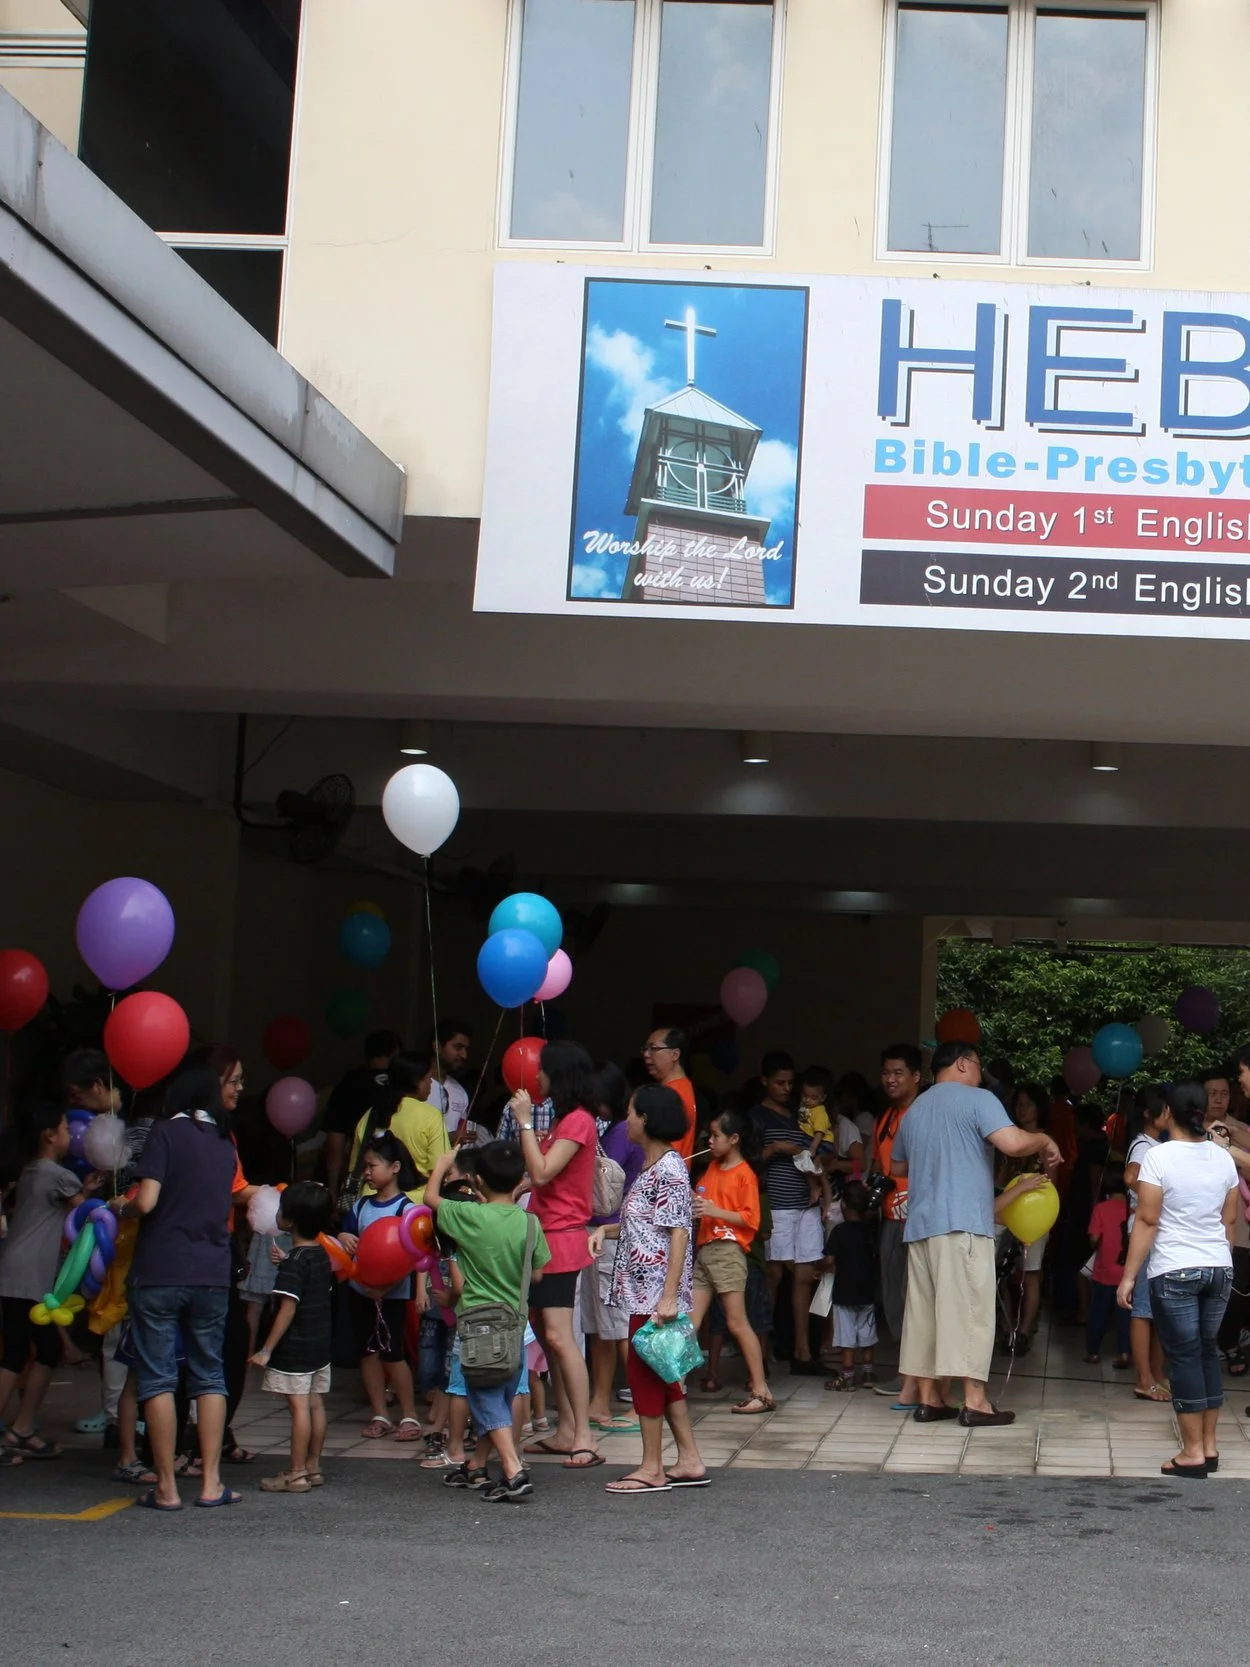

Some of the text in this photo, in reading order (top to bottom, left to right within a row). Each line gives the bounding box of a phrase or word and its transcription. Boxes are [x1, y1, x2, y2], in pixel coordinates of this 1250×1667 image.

[926, 500, 1058, 540] Sunday
[1072, 505, 1114, 534] 1st
[583, 530, 785, 562] Worship the Lord
[634, 566, 729, 590] with us!
[923, 565, 1055, 605] Sunday
[1067, 571, 1119, 600] 2nd
